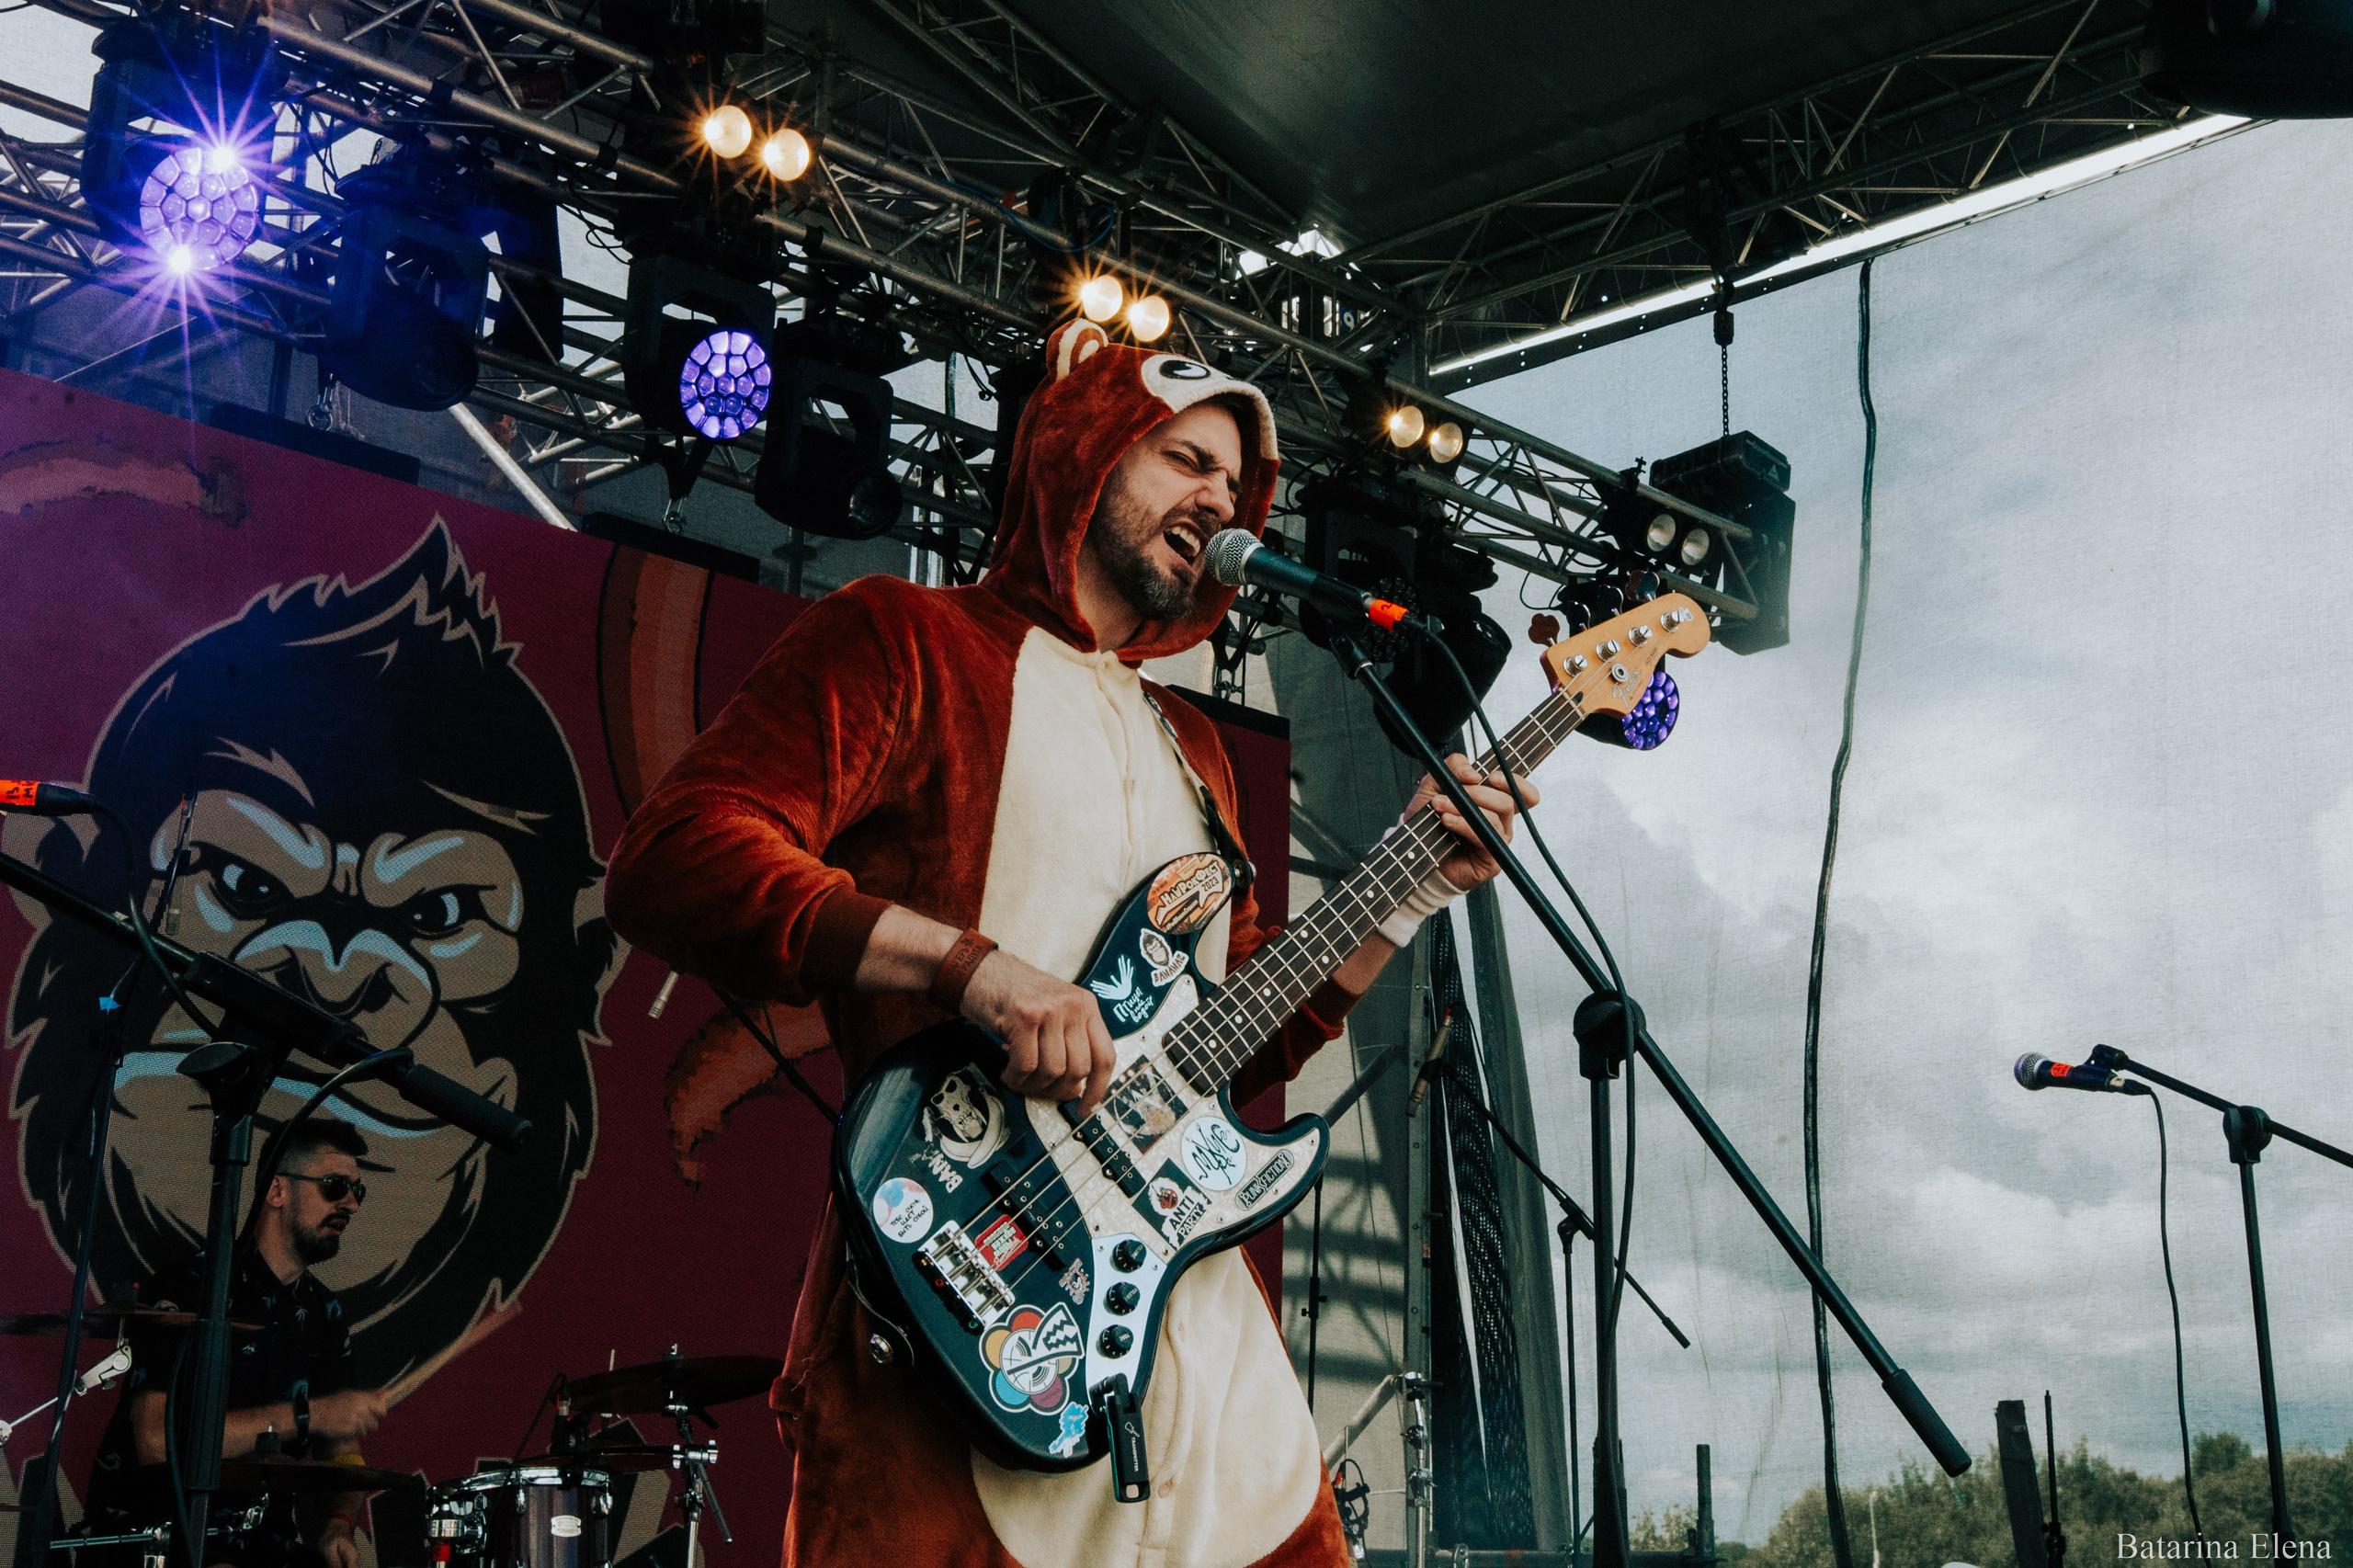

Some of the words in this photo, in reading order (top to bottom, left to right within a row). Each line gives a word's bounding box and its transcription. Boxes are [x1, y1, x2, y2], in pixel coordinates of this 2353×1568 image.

[1612, 670, 1641, 708] Fender
[1201, 876, 1220, 892] 2023
[1154, 953, 1186, 983] BANANAZ
[1240, 1178, 1264, 1205] PUNK
[1261, 1155, 1290, 1191] FICTION
[1169, 1195, 1194, 1231] ANTI
[1179, 1204, 1205, 1238] PARTY
